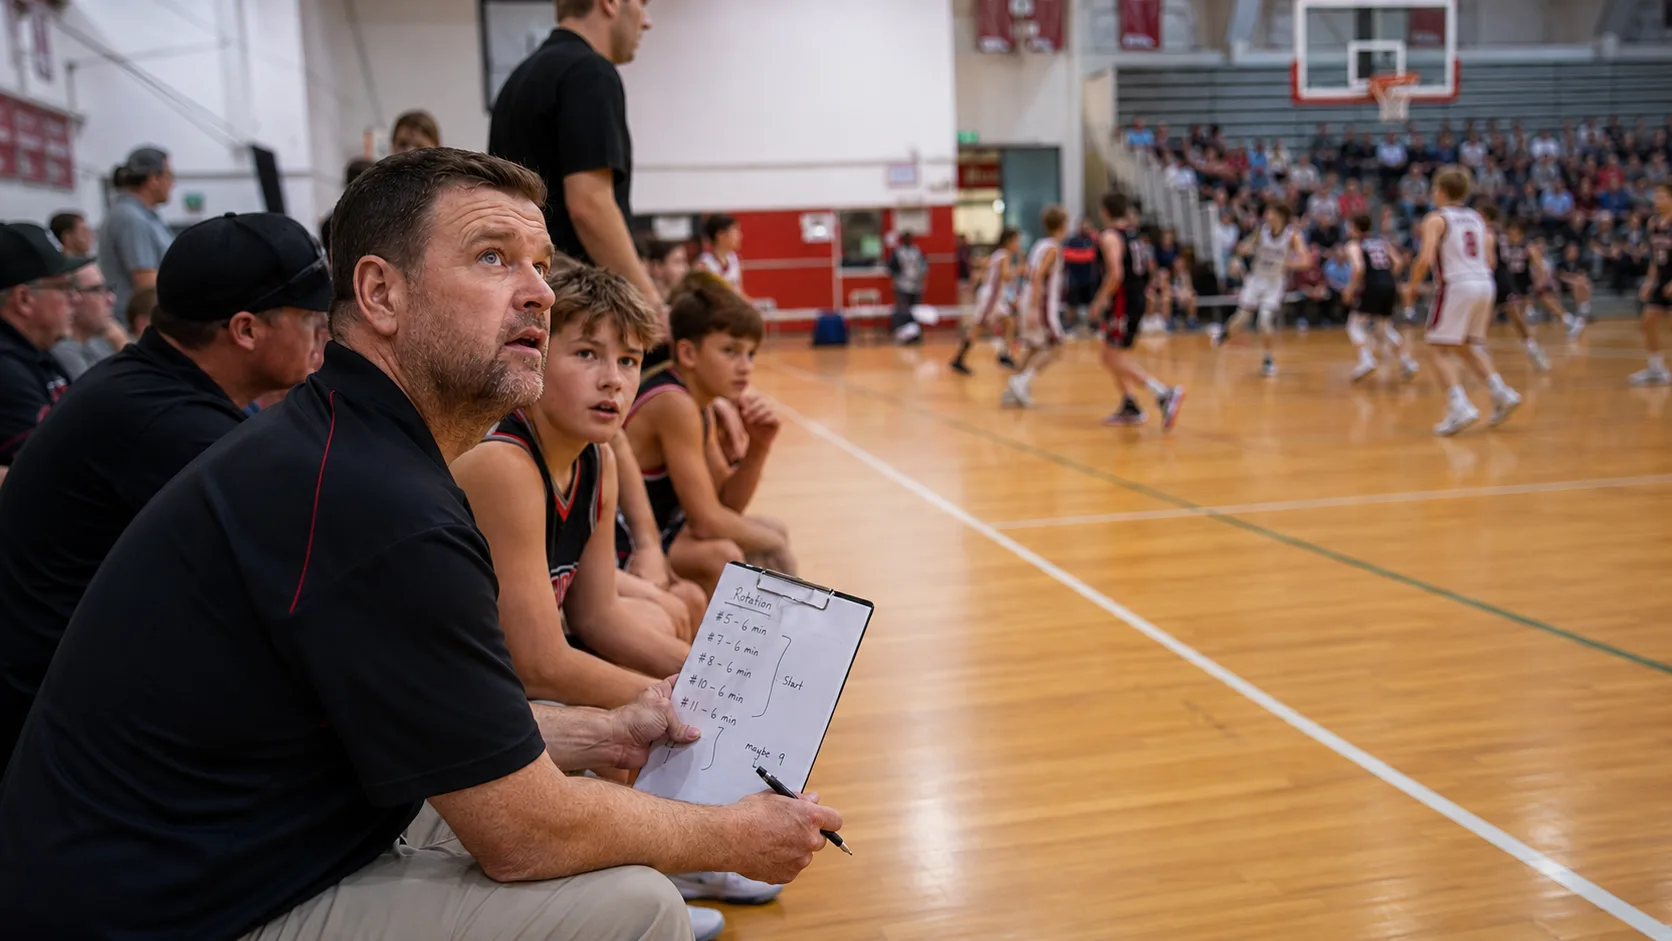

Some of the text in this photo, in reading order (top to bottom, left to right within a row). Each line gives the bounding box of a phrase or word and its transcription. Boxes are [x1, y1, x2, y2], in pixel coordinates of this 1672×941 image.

[733, 586, 772, 610] Rotation
[741, 618, 750, 631] 6
[751, 625, 767, 636] min
[733, 640, 741, 651] 6
[743, 646, 759, 656] min
[726, 661, 733, 673] 6
[735, 668, 752, 678] min
[782, 676, 803, 690] Start
[718, 684, 726, 697] 6
[727, 692, 744, 703] min
[710, 707, 718, 719] 6
[720, 715, 737, 726] min
[744, 743, 786, 766] maybe 9
